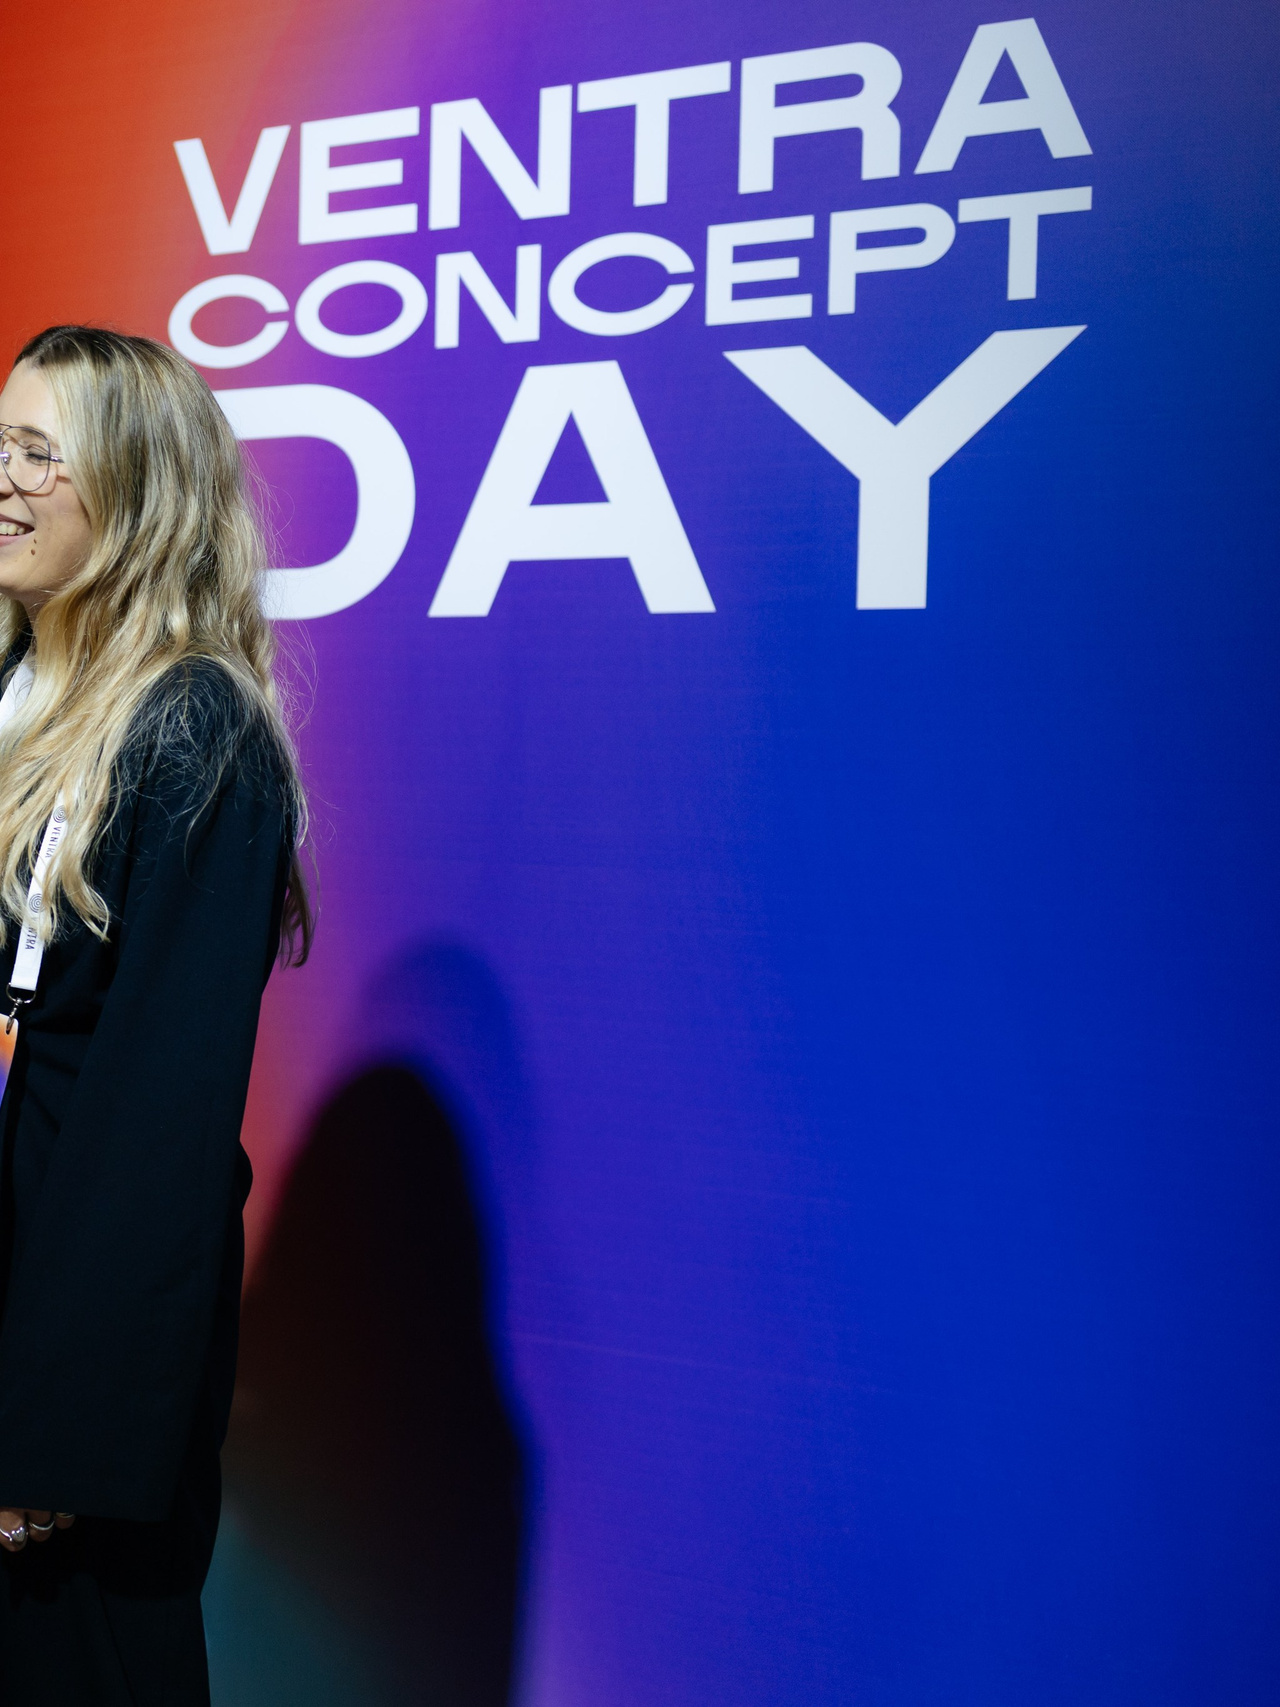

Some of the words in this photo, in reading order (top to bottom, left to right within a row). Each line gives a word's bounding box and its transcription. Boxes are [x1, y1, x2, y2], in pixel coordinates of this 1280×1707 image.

[174, 17, 1094, 255] VENTRA
[168, 186, 1094, 369] CONCEPT
[214, 325, 1088, 621] DAY
